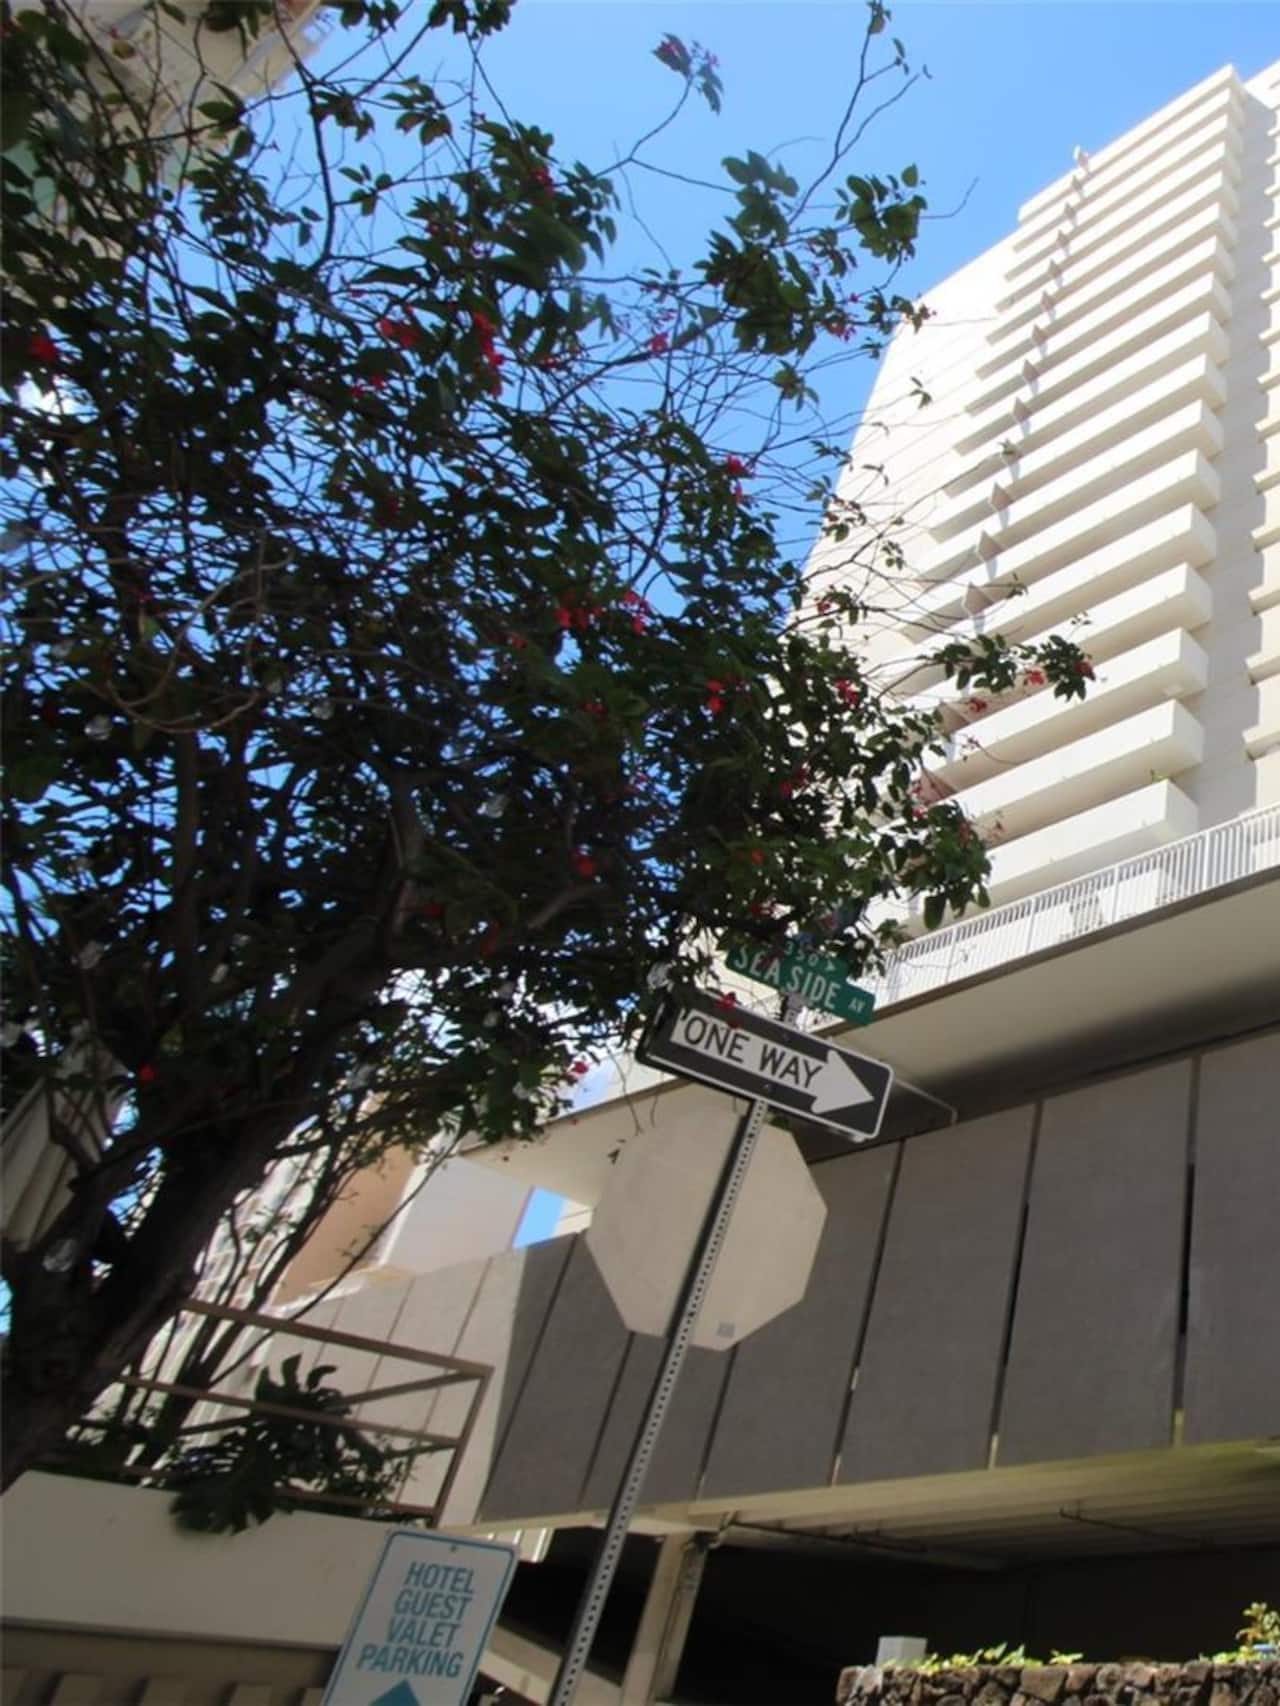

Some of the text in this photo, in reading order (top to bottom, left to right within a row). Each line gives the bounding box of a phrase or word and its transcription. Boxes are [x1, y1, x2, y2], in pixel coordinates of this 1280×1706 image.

[684, 1016, 823, 1088] ONE WAY
[404, 1561, 475, 1594] HOTEL
[393, 1589, 473, 1620] GUEST
[387, 1616, 462, 1648] VALET
[356, 1644, 464, 1678] PARKING
